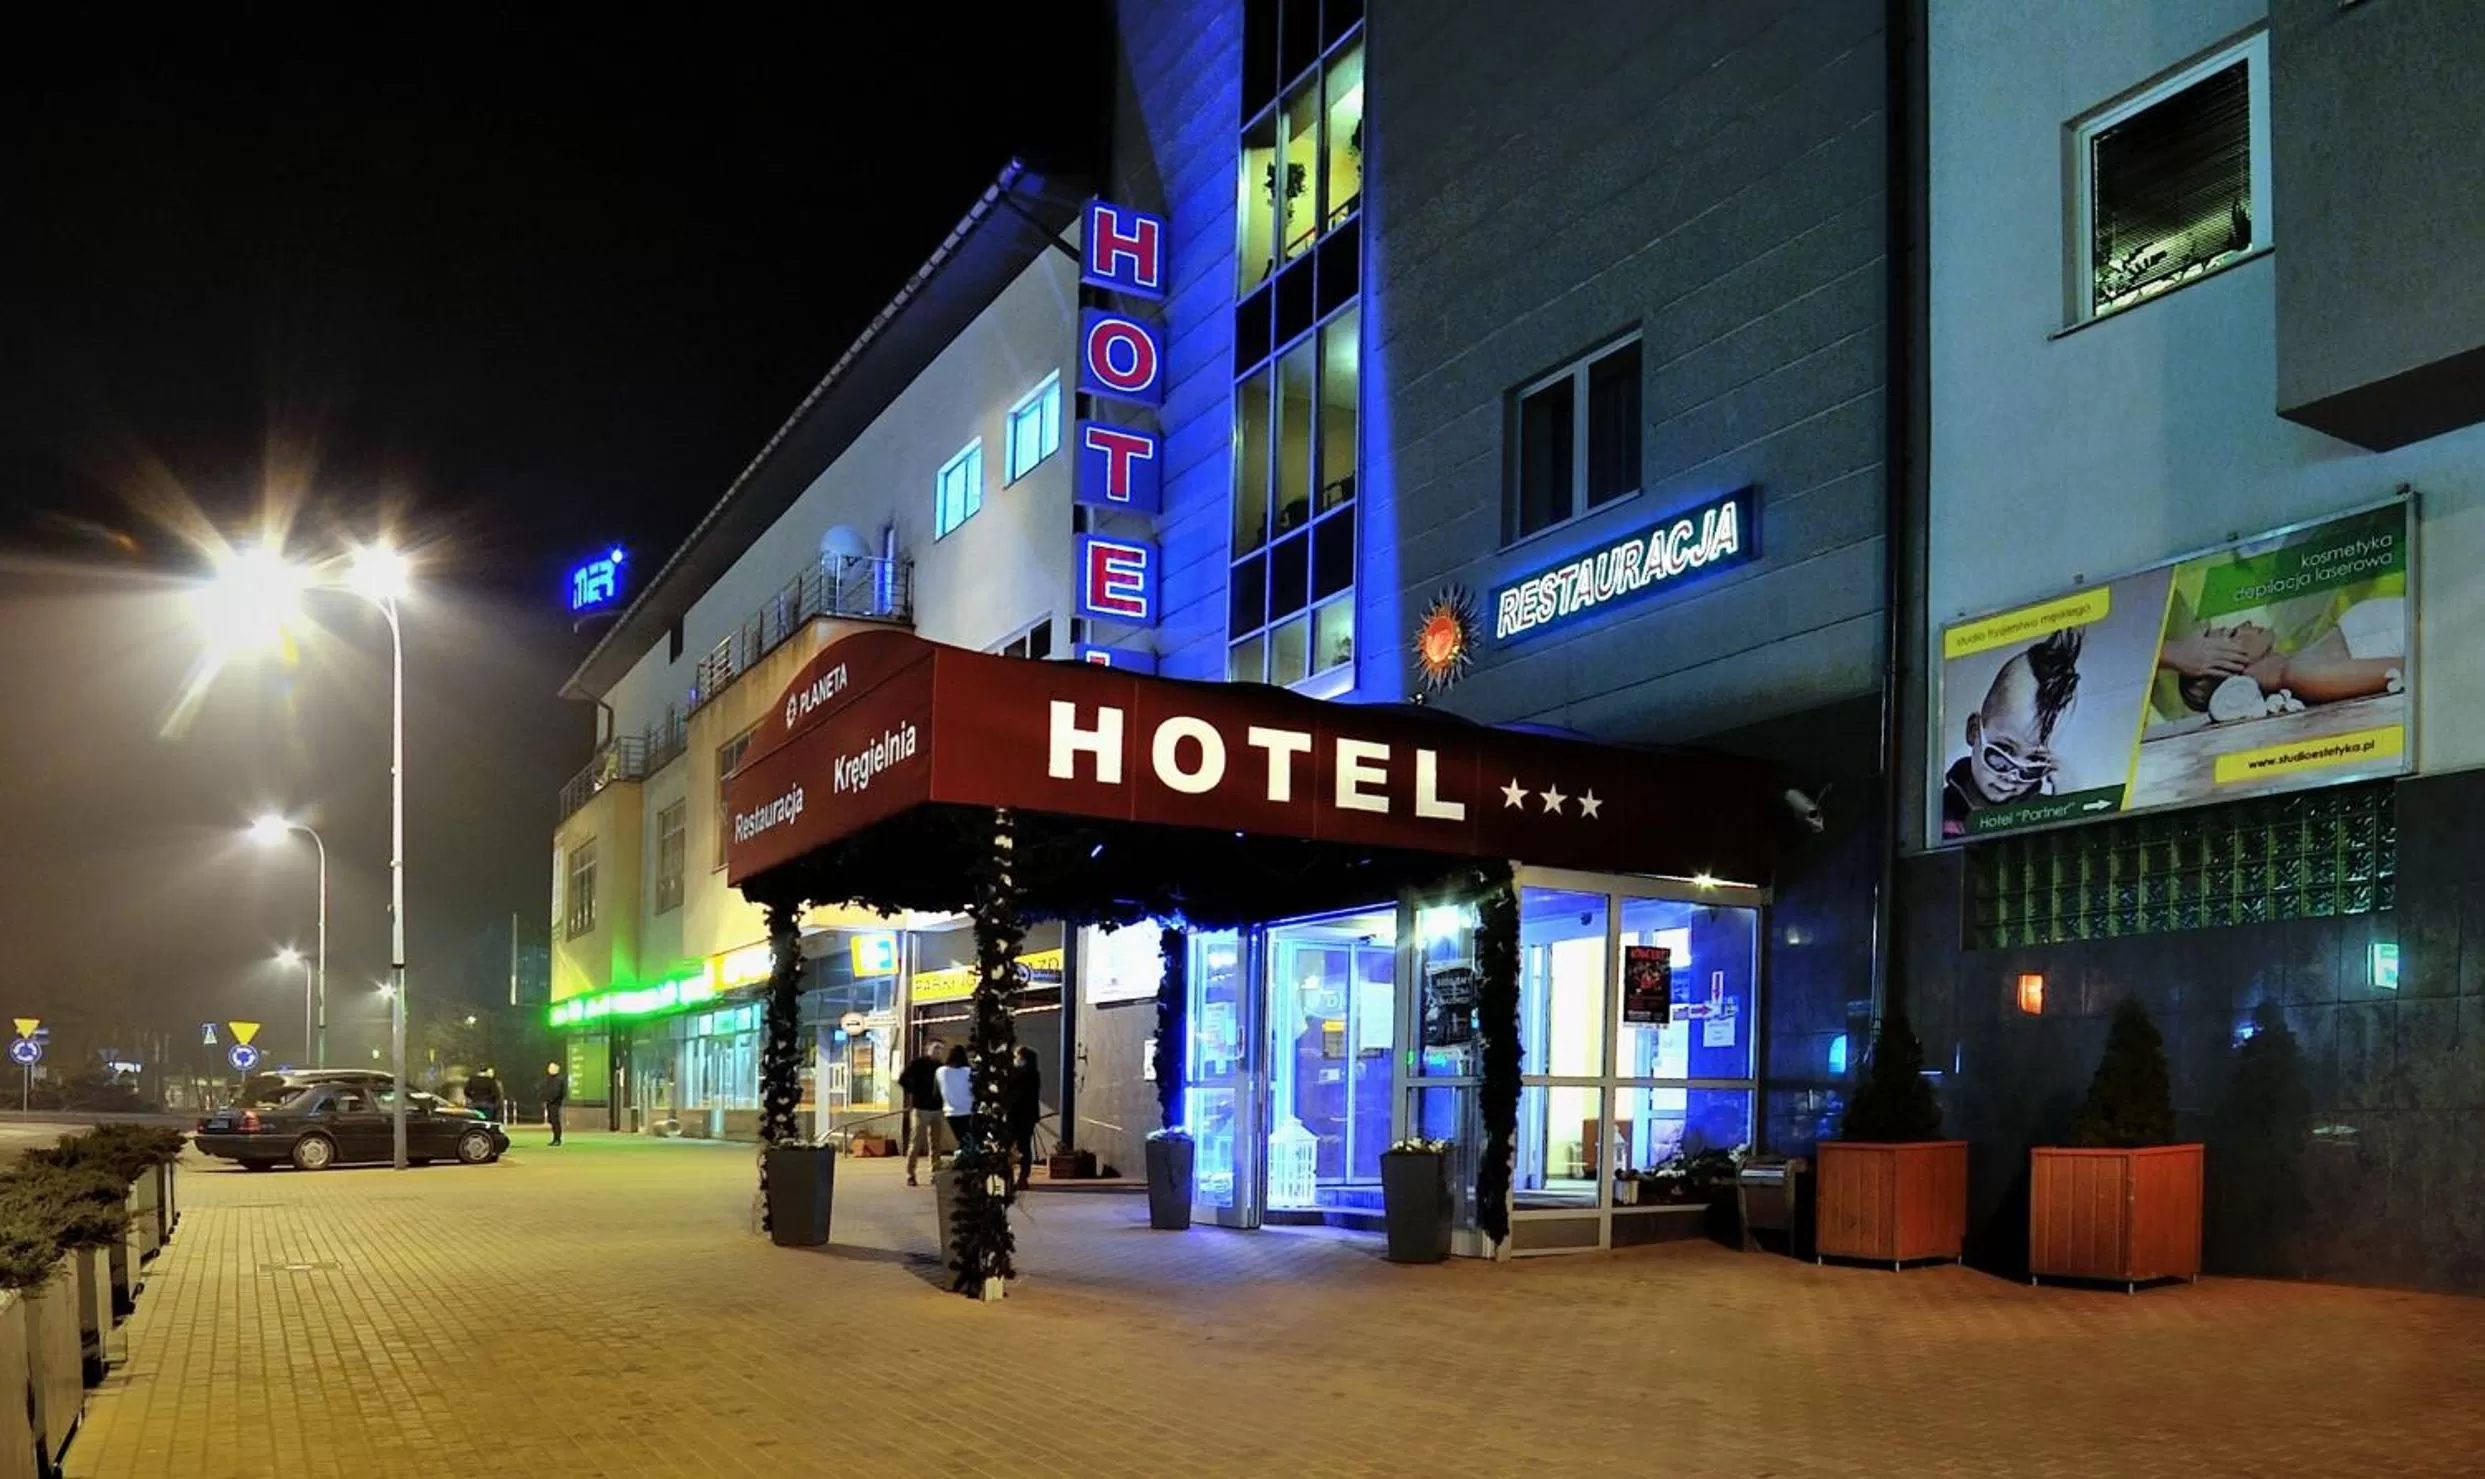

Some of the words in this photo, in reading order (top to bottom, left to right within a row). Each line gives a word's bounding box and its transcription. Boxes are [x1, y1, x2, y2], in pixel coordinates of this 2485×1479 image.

[1086, 205, 1158, 667] HOTE
[1497, 501, 1739, 639] RESTAURACJA
[2234, 570, 2311, 601] depilacja
[2315, 552, 2393, 581] laserowa
[2301, 534, 2393, 568] kosmetyka
[800, 662, 848, 717] PLANETA
[834, 720, 916, 793] Kręgielnia
[1048, 700, 1465, 821] HOTEL
[2248, 739, 2375, 769] www.studioestetyka.pl
[734, 783, 804, 844] Restauracja
[1979, 811, 2013, 829] Hotel
